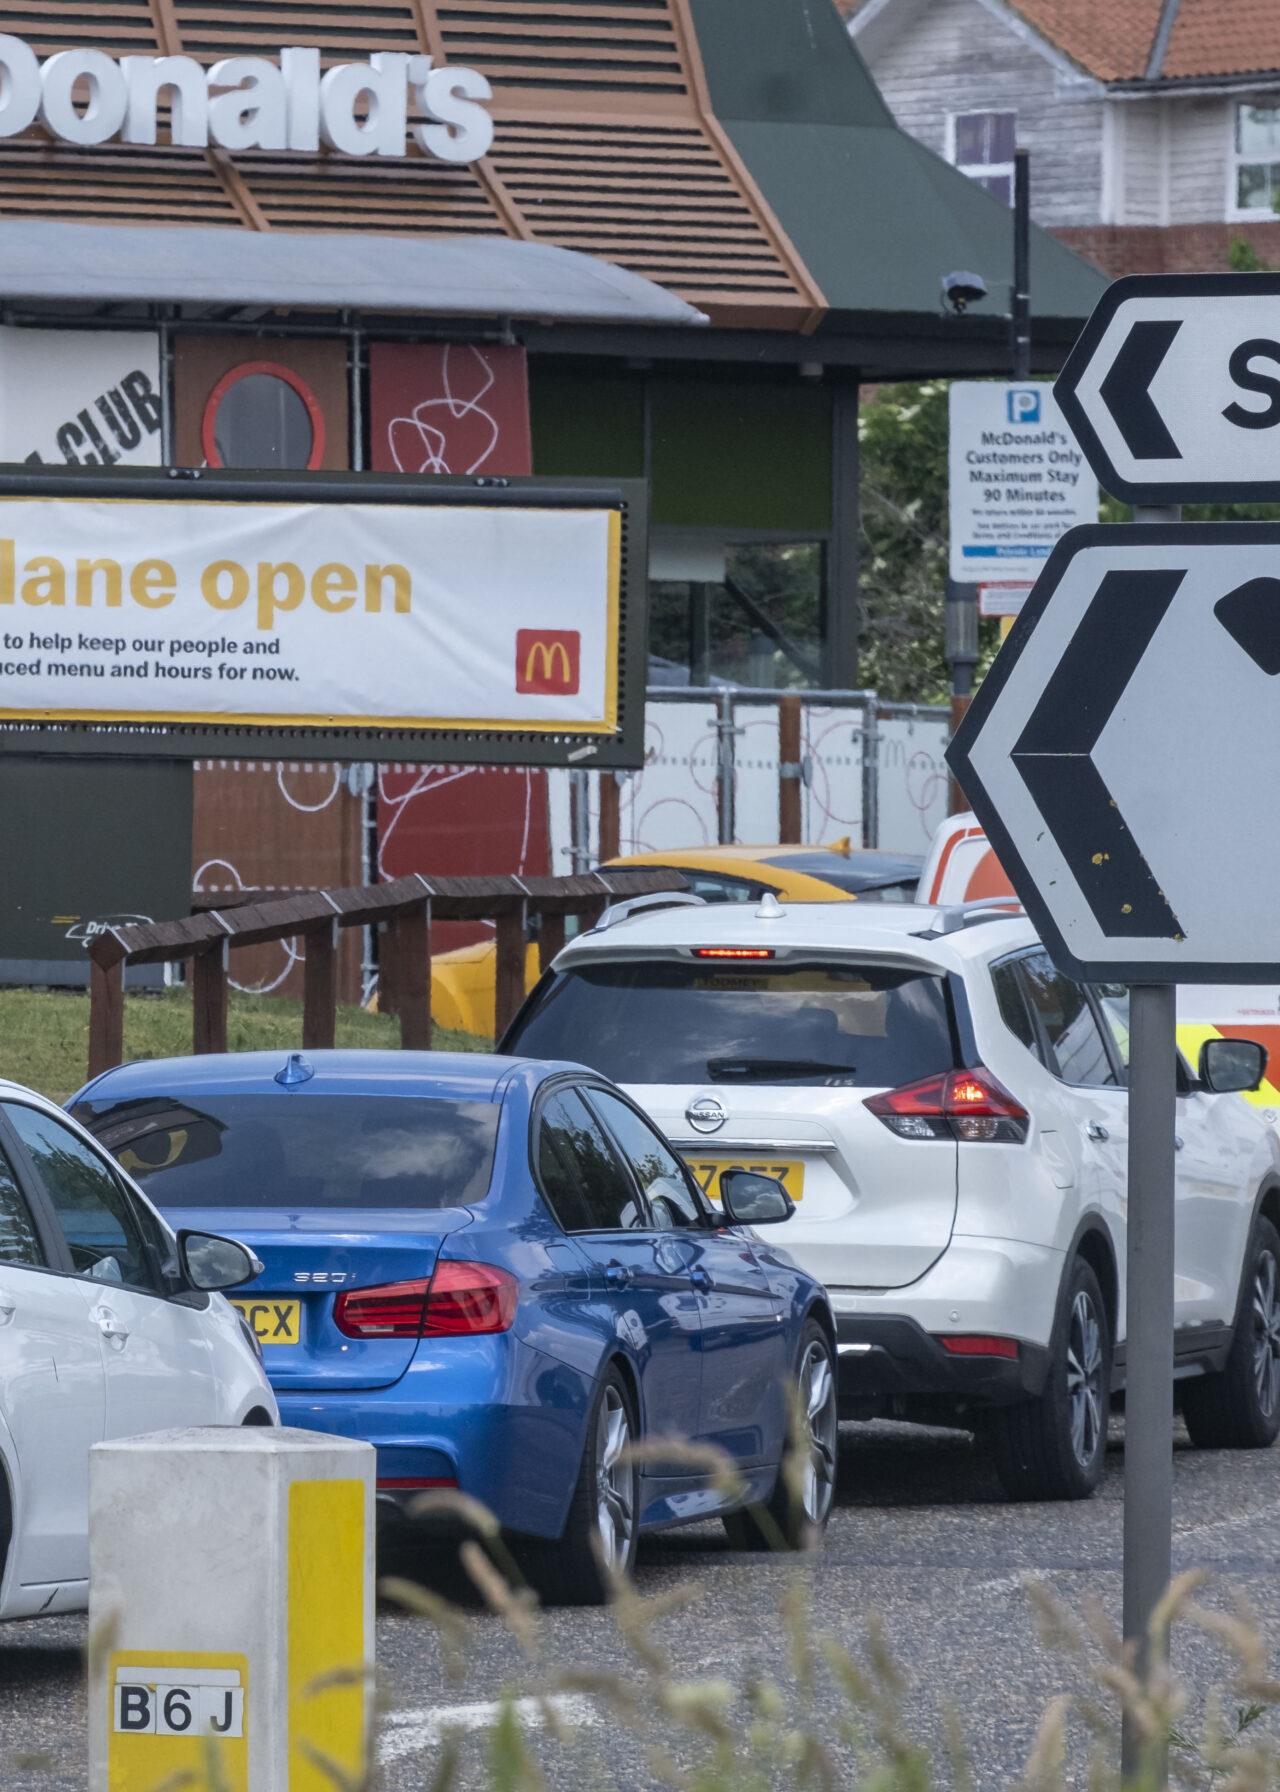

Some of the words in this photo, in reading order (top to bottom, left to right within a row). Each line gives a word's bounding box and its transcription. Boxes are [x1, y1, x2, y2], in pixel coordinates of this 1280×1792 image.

[57, 370, 161, 465] CLUB
[981, 431, 1067, 446] McDonald's
[966, 450, 1044, 465] Customers
[1048, 449, 1082, 467] Only
[970, 470, 1042, 483] Maximum
[1047, 469, 1079, 486] Stay
[984, 489, 1001, 502] 90
[1006, 488, 1066, 502] Minutes
[0, 540, 175, 607] lane
[202, 561, 410, 629] open
[4, 634, 23, 649] to
[30, 633, 72, 653] help
[78, 634, 126, 655] keep
[132, 640, 164, 652] our
[170, 637, 237, 657] people
[243, 638, 279, 654] and
[48, 664, 104, 677] menu
[111, 661, 148, 678] and
[155, 662, 212, 679] hours
[218, 663, 247, 680] for
[252, 668, 299, 681] now.
[687, 1110, 725, 1119] NISSAN
[234, 1305, 294, 1337] CX
